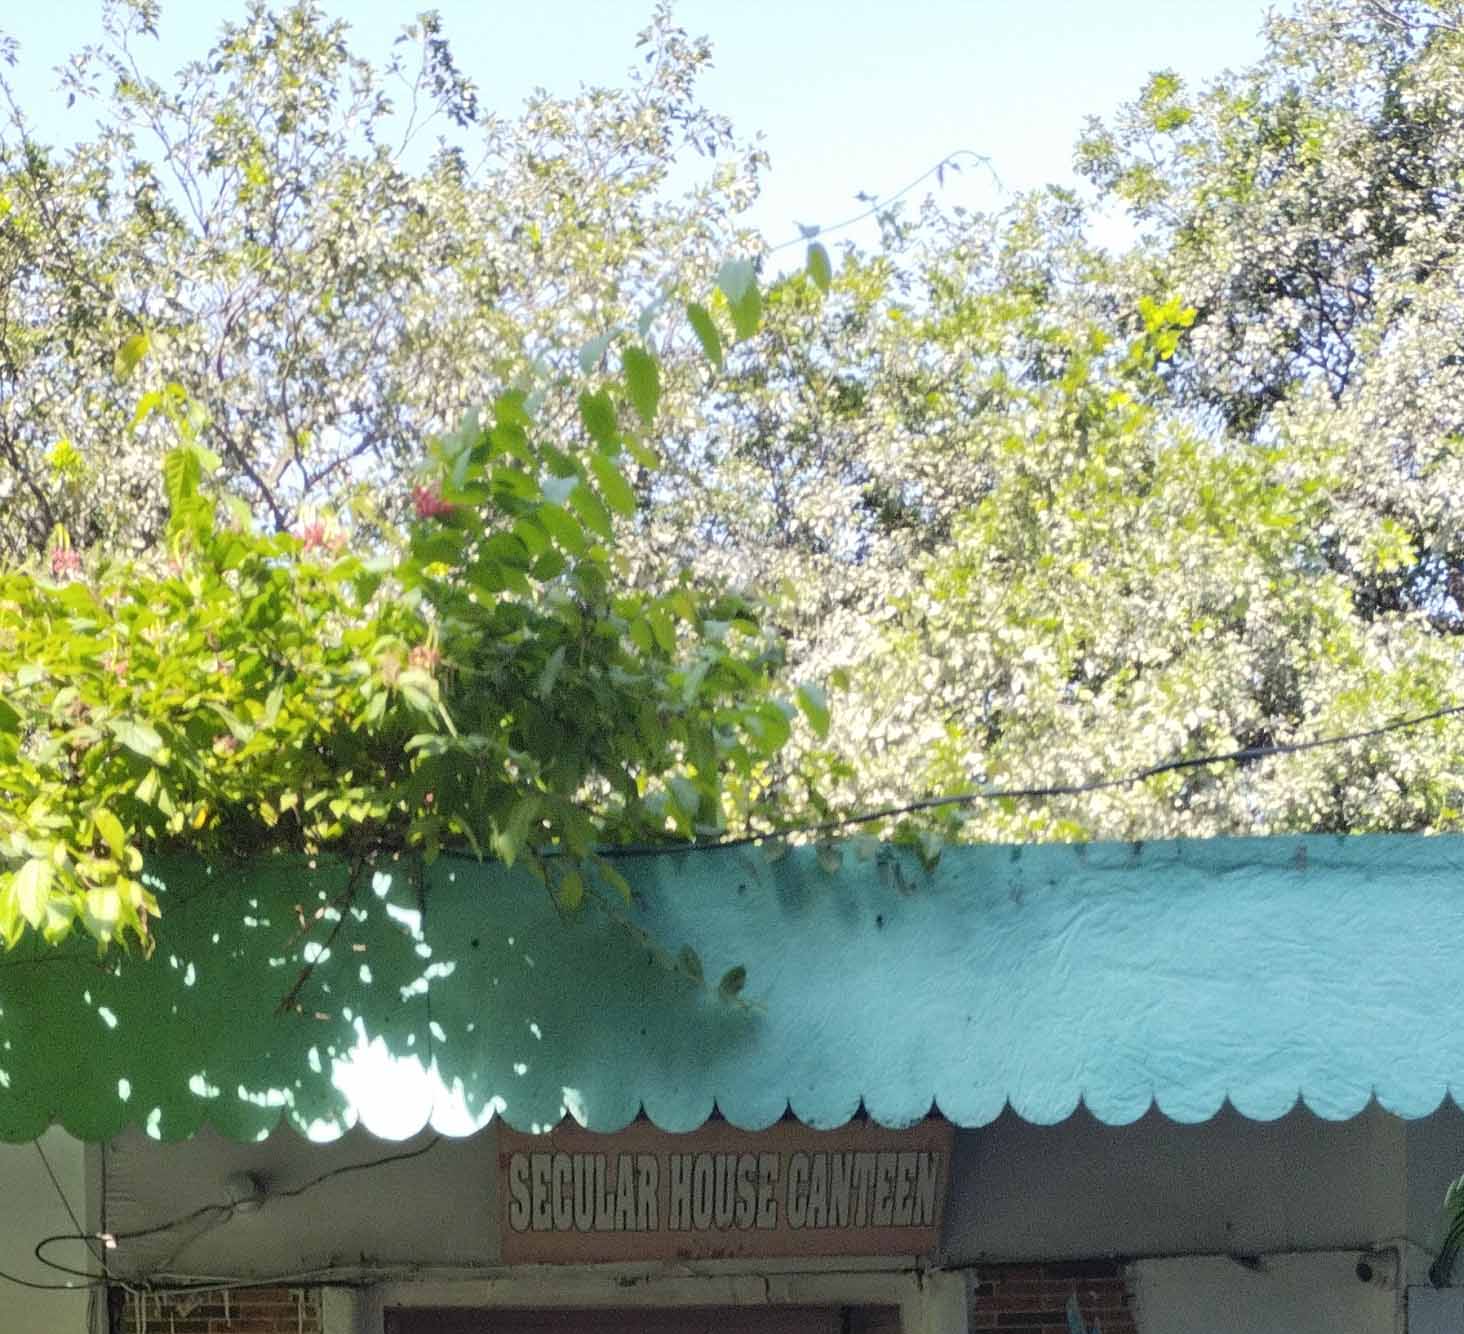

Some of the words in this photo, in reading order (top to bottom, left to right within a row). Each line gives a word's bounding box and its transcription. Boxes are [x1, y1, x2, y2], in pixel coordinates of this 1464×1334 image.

[508, 1151, 661, 1233] SECULAR
[668, 1151, 782, 1232] HOUSE
[786, 1151, 942, 1230] CANTEEN
